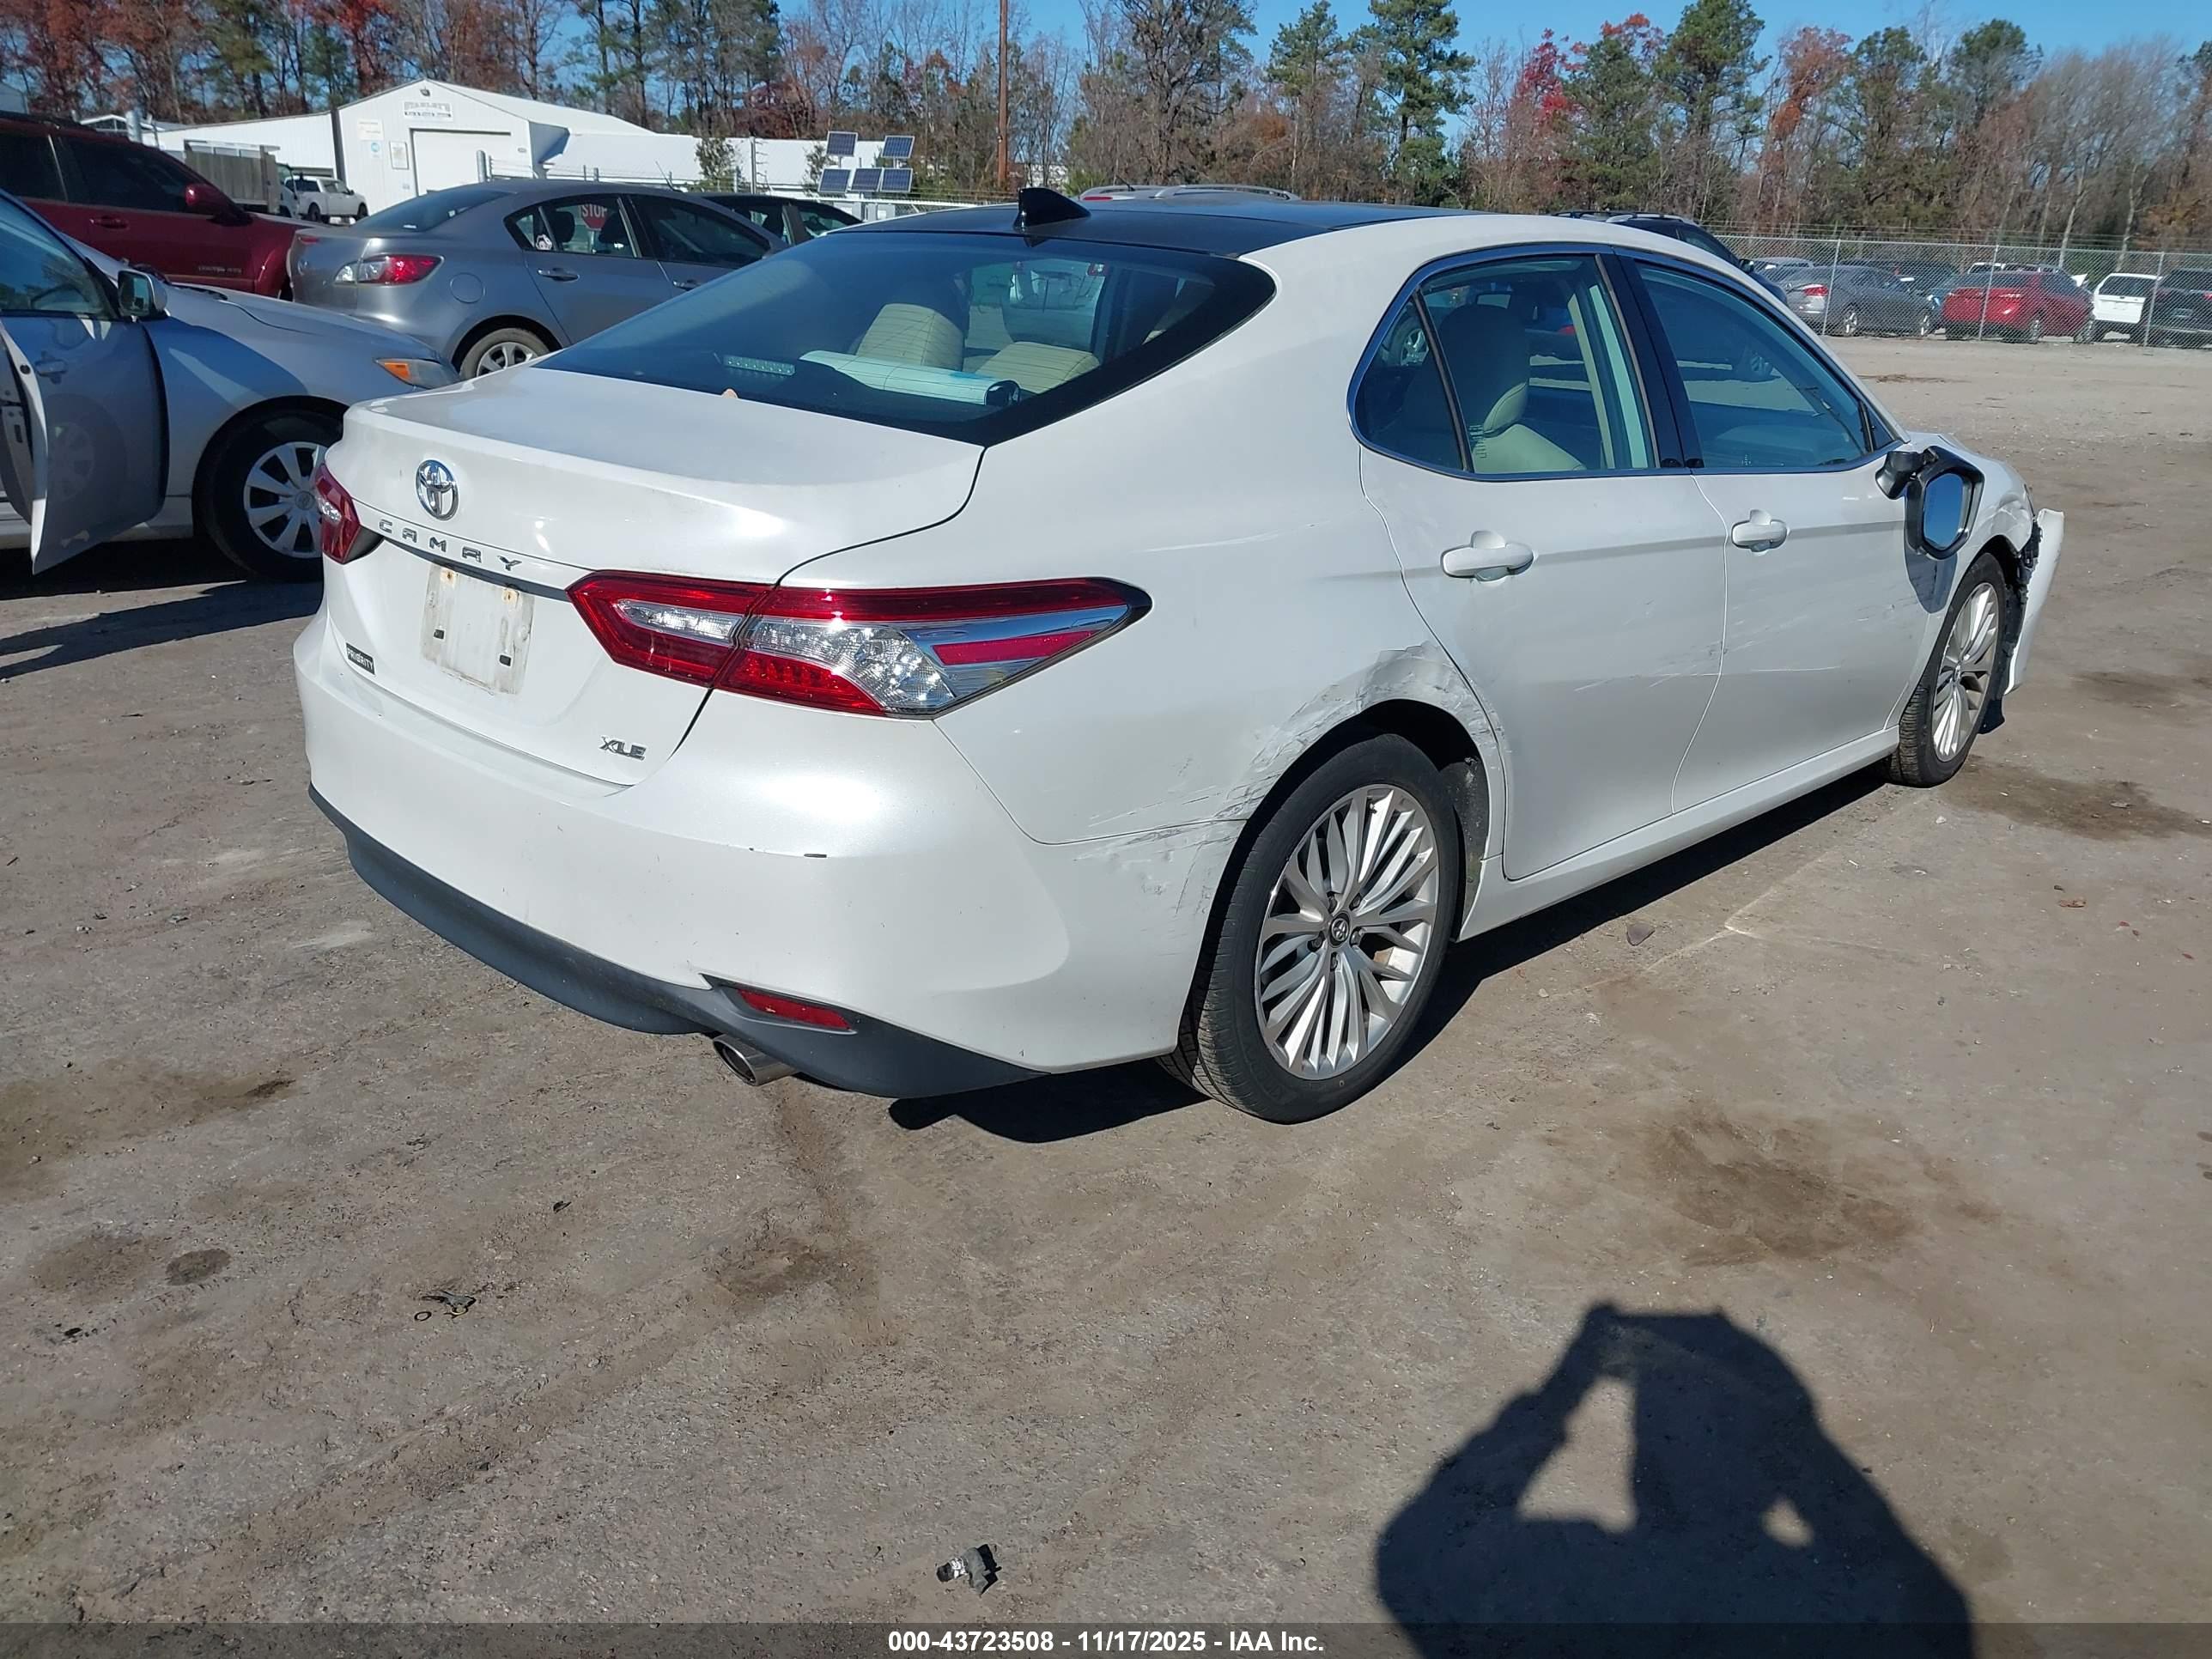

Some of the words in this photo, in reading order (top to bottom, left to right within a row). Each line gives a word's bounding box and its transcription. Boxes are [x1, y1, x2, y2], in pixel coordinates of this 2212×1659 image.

[581, 204, 608, 218] STOP
[379, 519, 522, 572] CAMRY
[347, 647, 374, 670] PRIORITY
[599, 736, 647, 761] XLE
